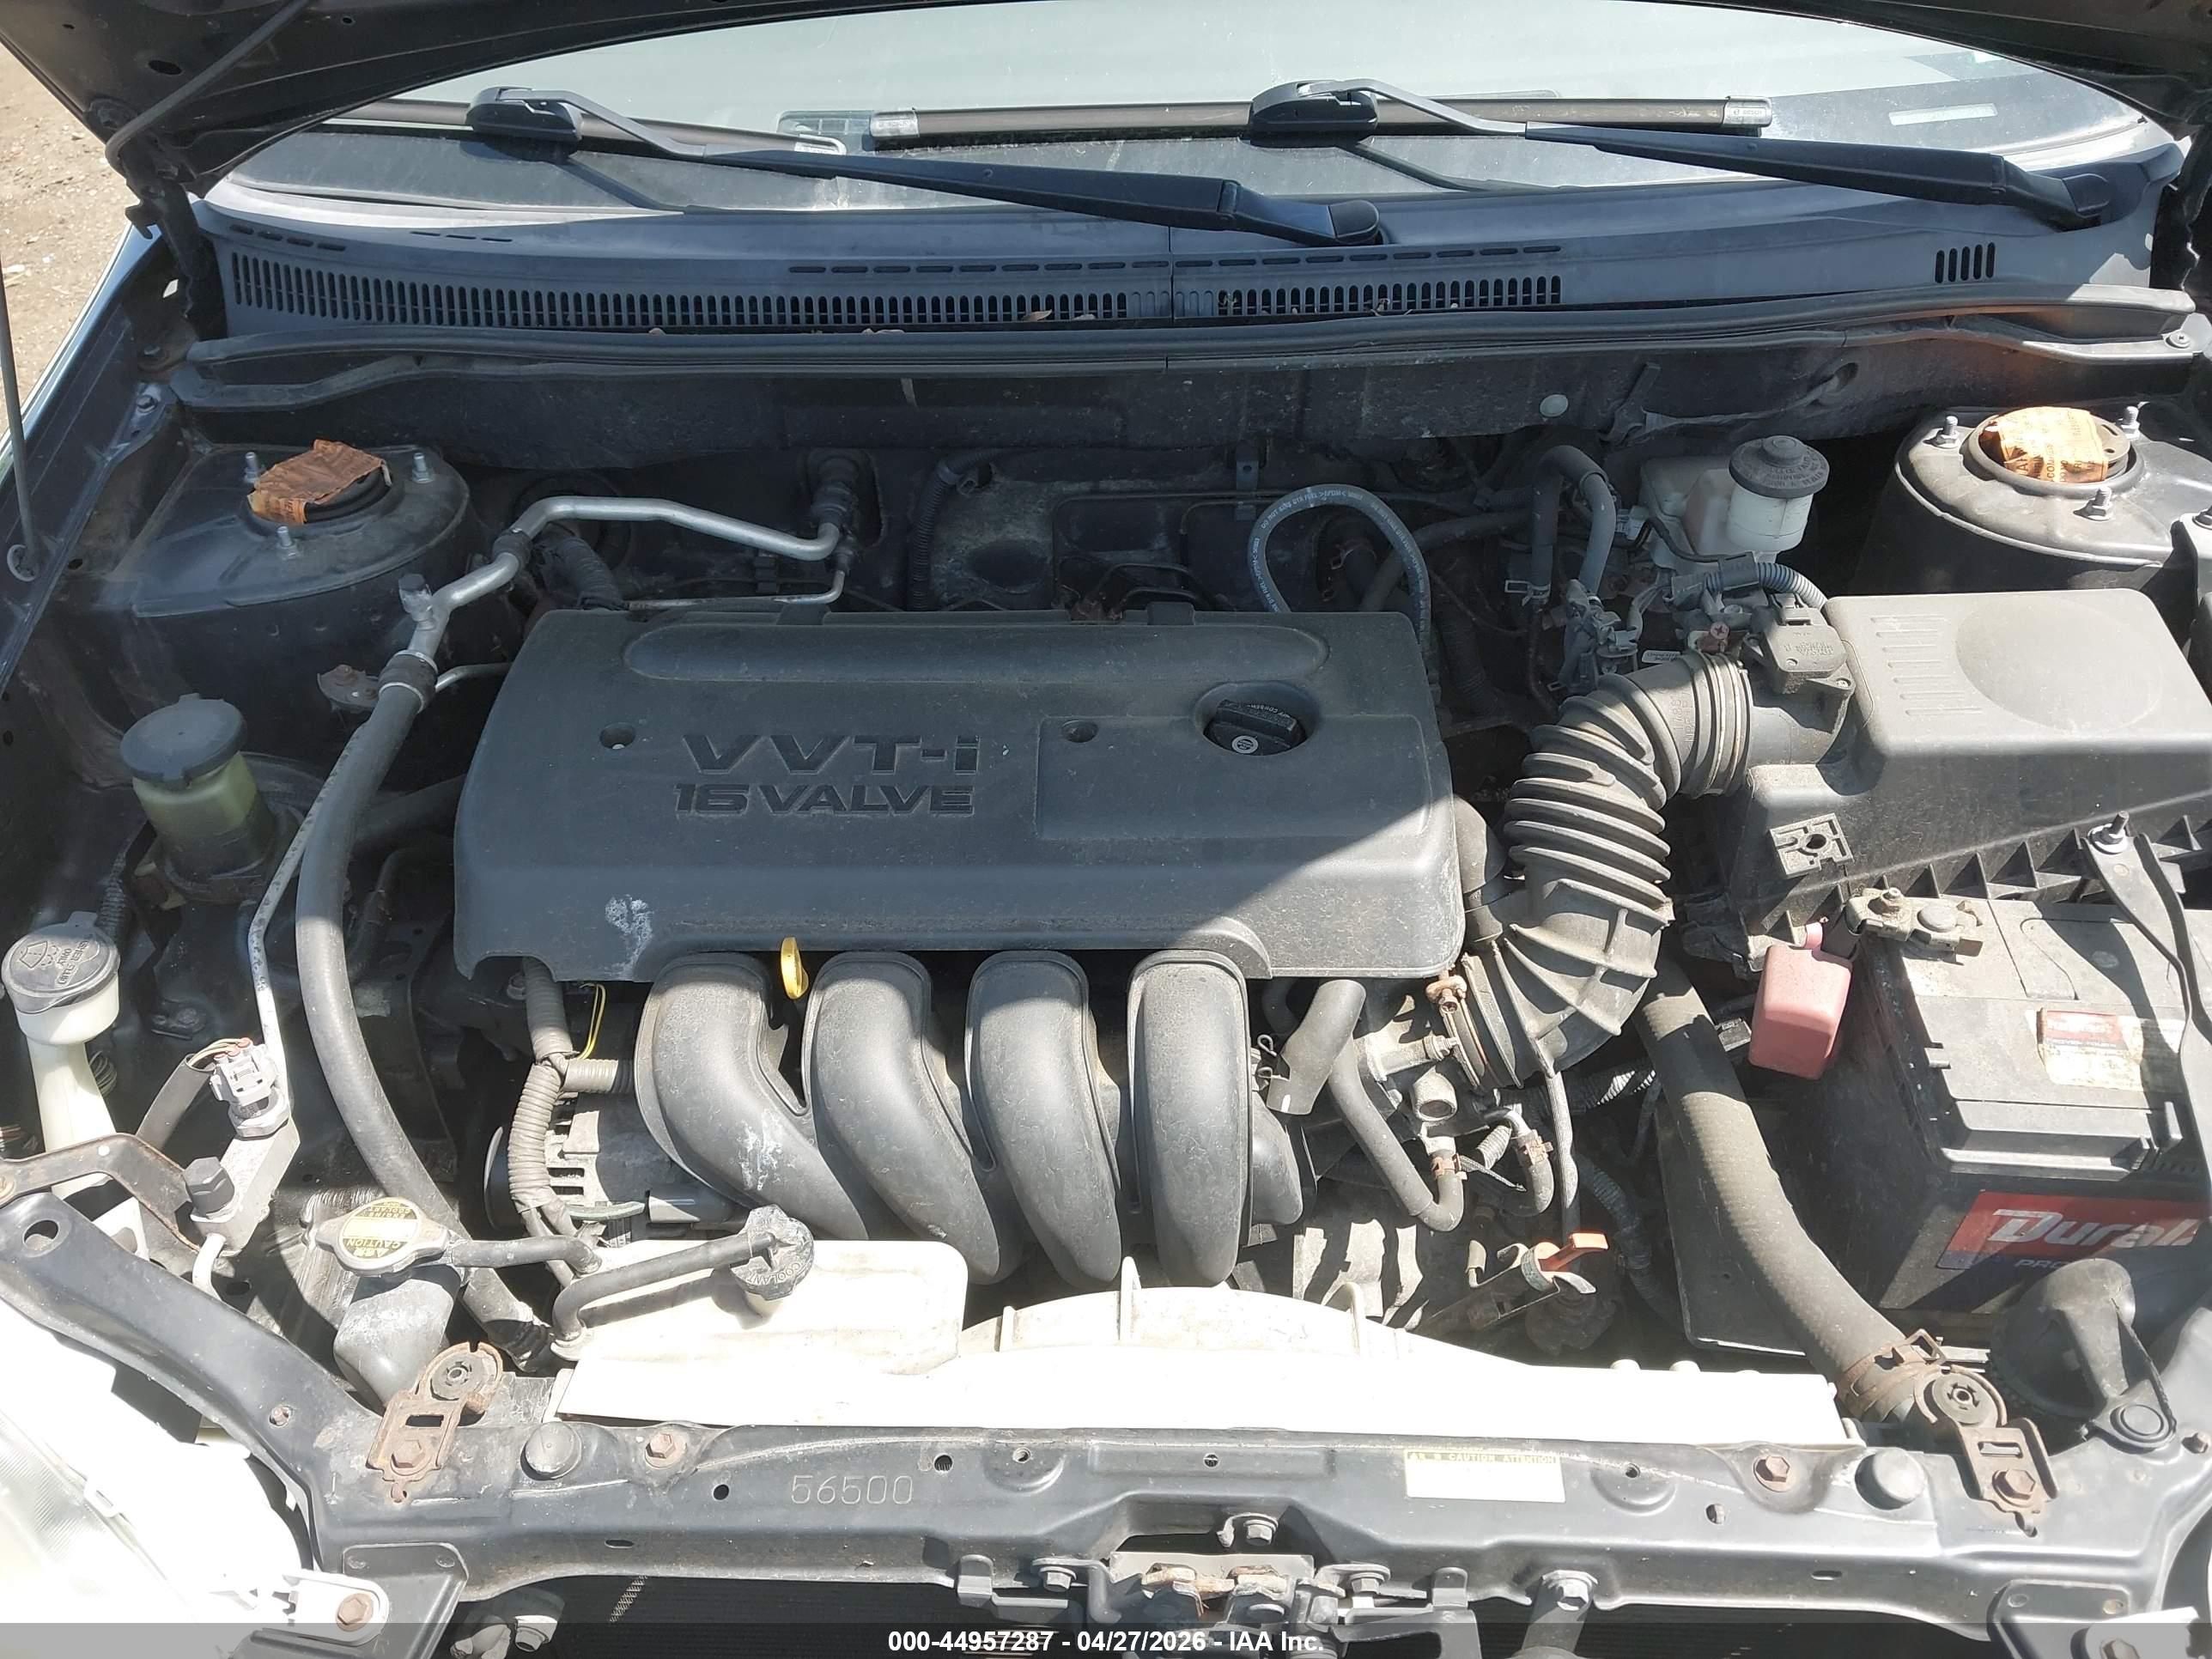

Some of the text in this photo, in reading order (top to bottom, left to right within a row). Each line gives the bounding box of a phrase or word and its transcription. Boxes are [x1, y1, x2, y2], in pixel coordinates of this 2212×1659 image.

[682, 735, 980, 775] VVT-i
[347, 1238, 403, 1249] CAUTION
[746, 1262, 801, 1285] COOLANT
[1449, 1454, 1495, 1462] CAUTION
[791, 1474, 913, 1504] 56500
